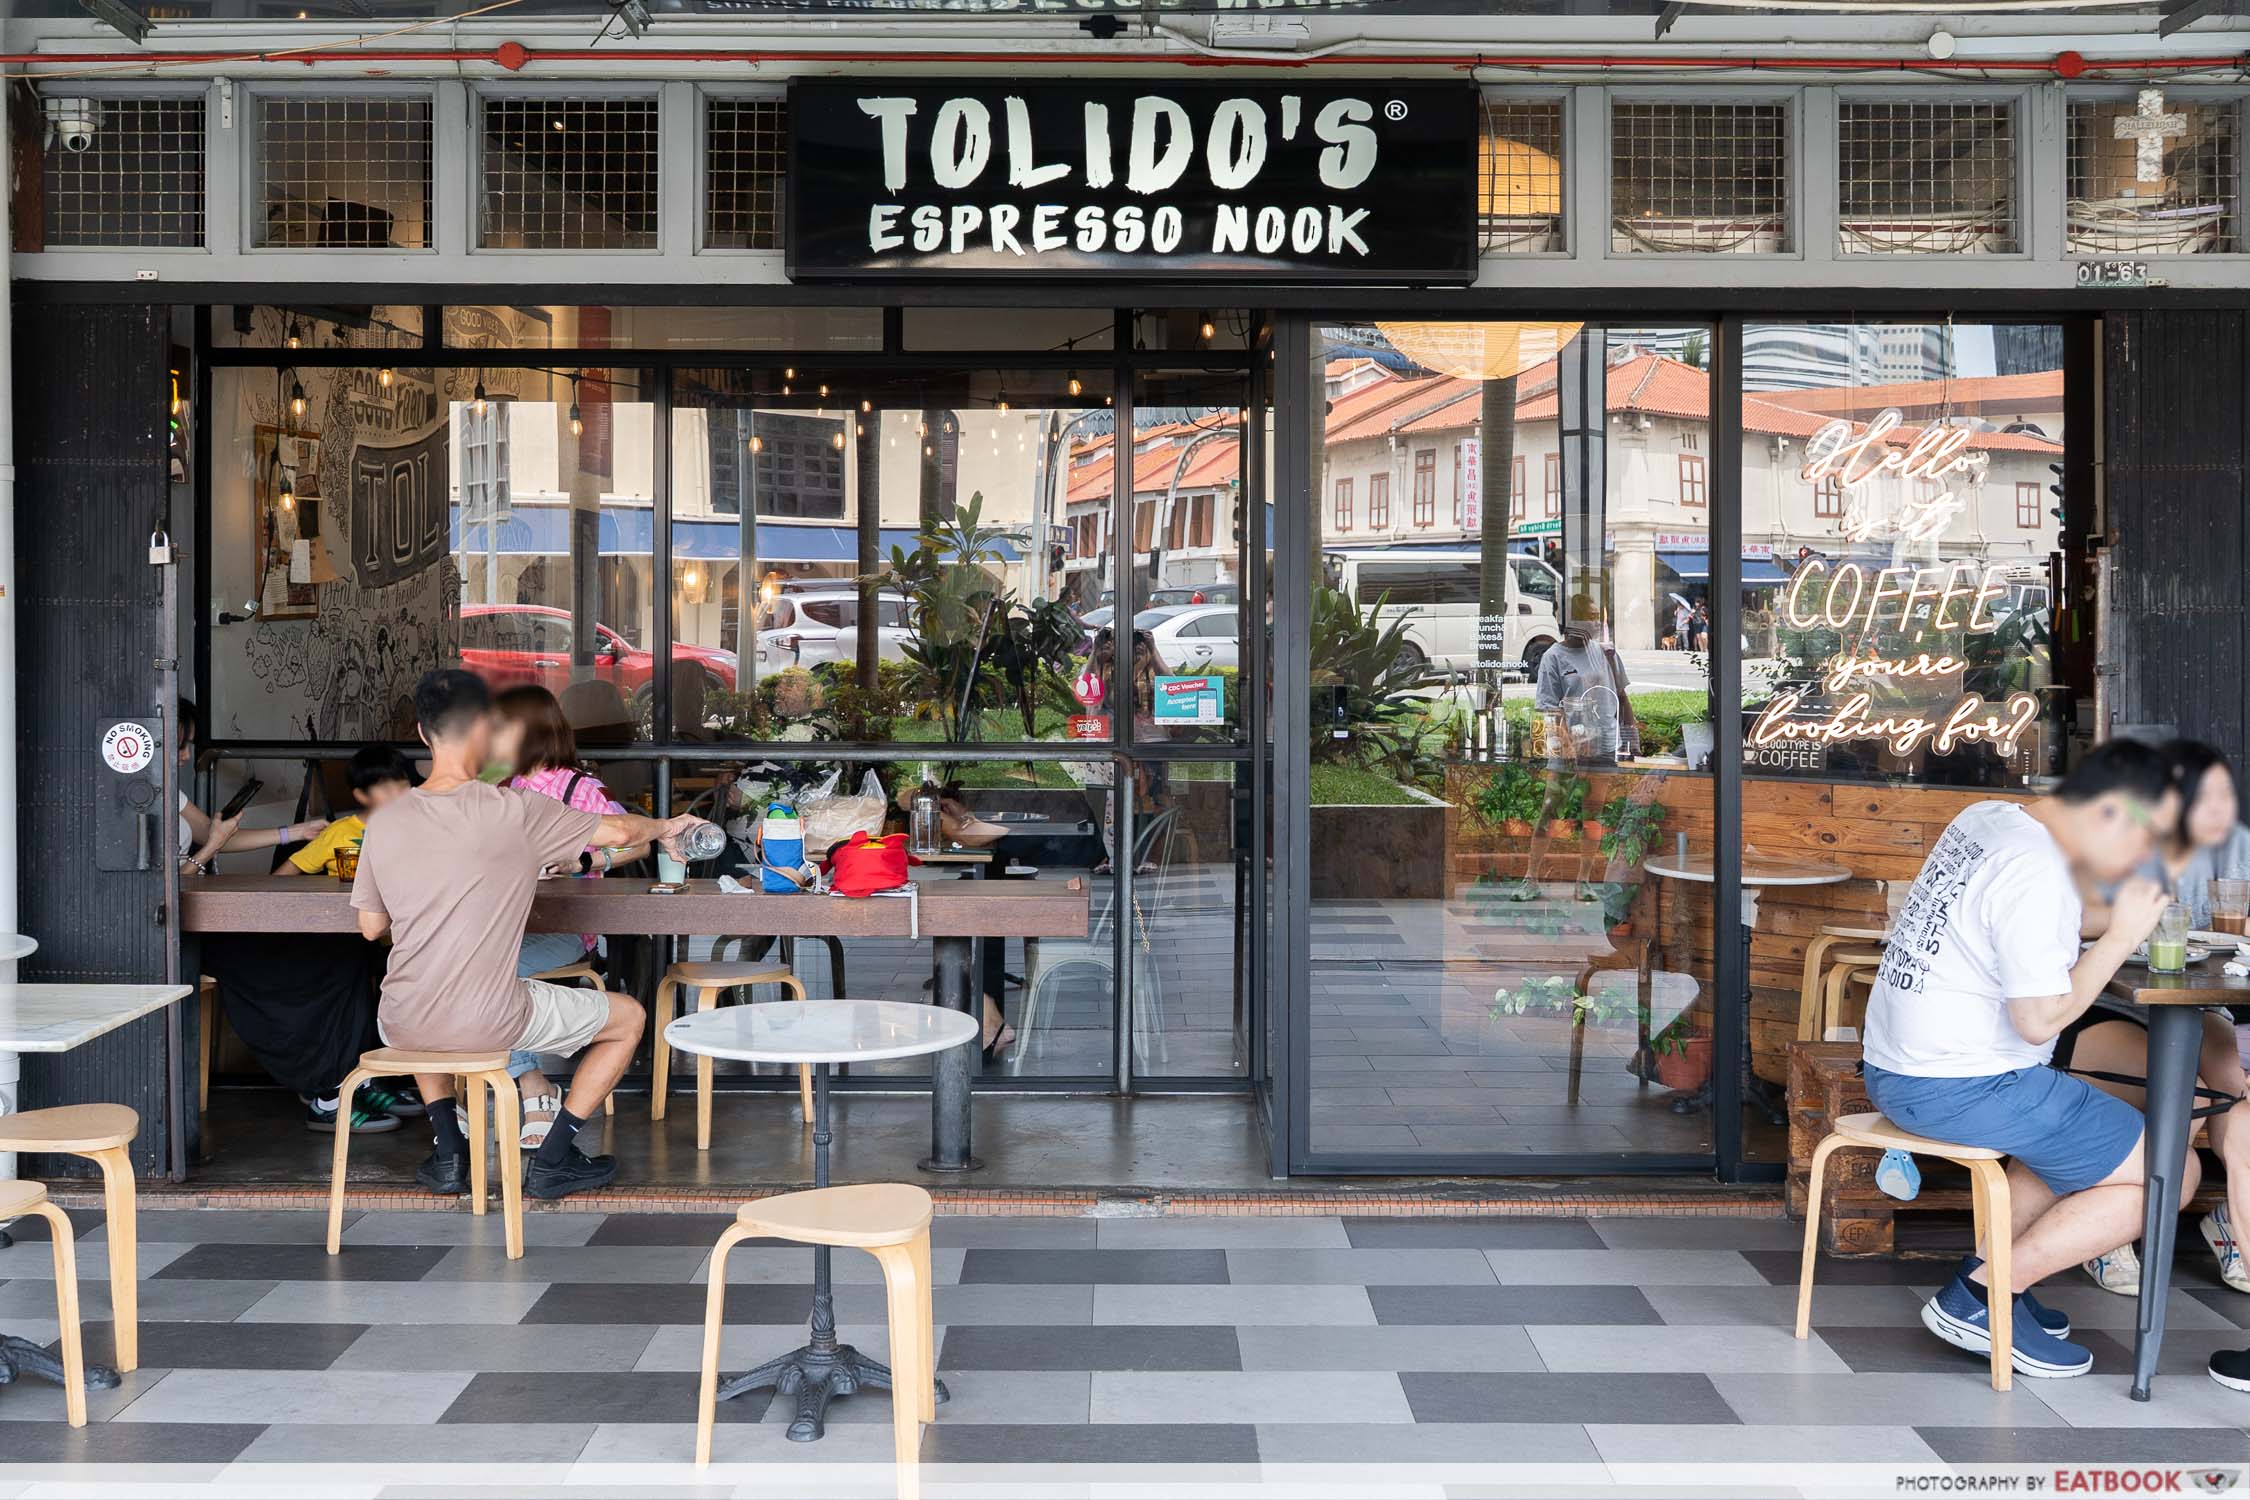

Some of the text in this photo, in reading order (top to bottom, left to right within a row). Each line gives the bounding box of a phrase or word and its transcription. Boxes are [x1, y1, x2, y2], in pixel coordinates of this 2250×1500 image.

[857, 96, 1378, 195] TOLIDO'S
[869, 204, 1371, 256] ESPRESSO NOOK
[2078, 265, 2147, 282] 01-63
[1788, 559, 2011, 632] COFFEE
[1168, 681, 1205, 692] CDC Voucher
[1755, 691, 2036, 750] looking for?
[106, 724, 151, 759] NO SMOKING
[1759, 750, 1820, 768] COFFEE
[1790, 740, 1810, 750] TYPE
[1811, 742, 1822, 751] IS
